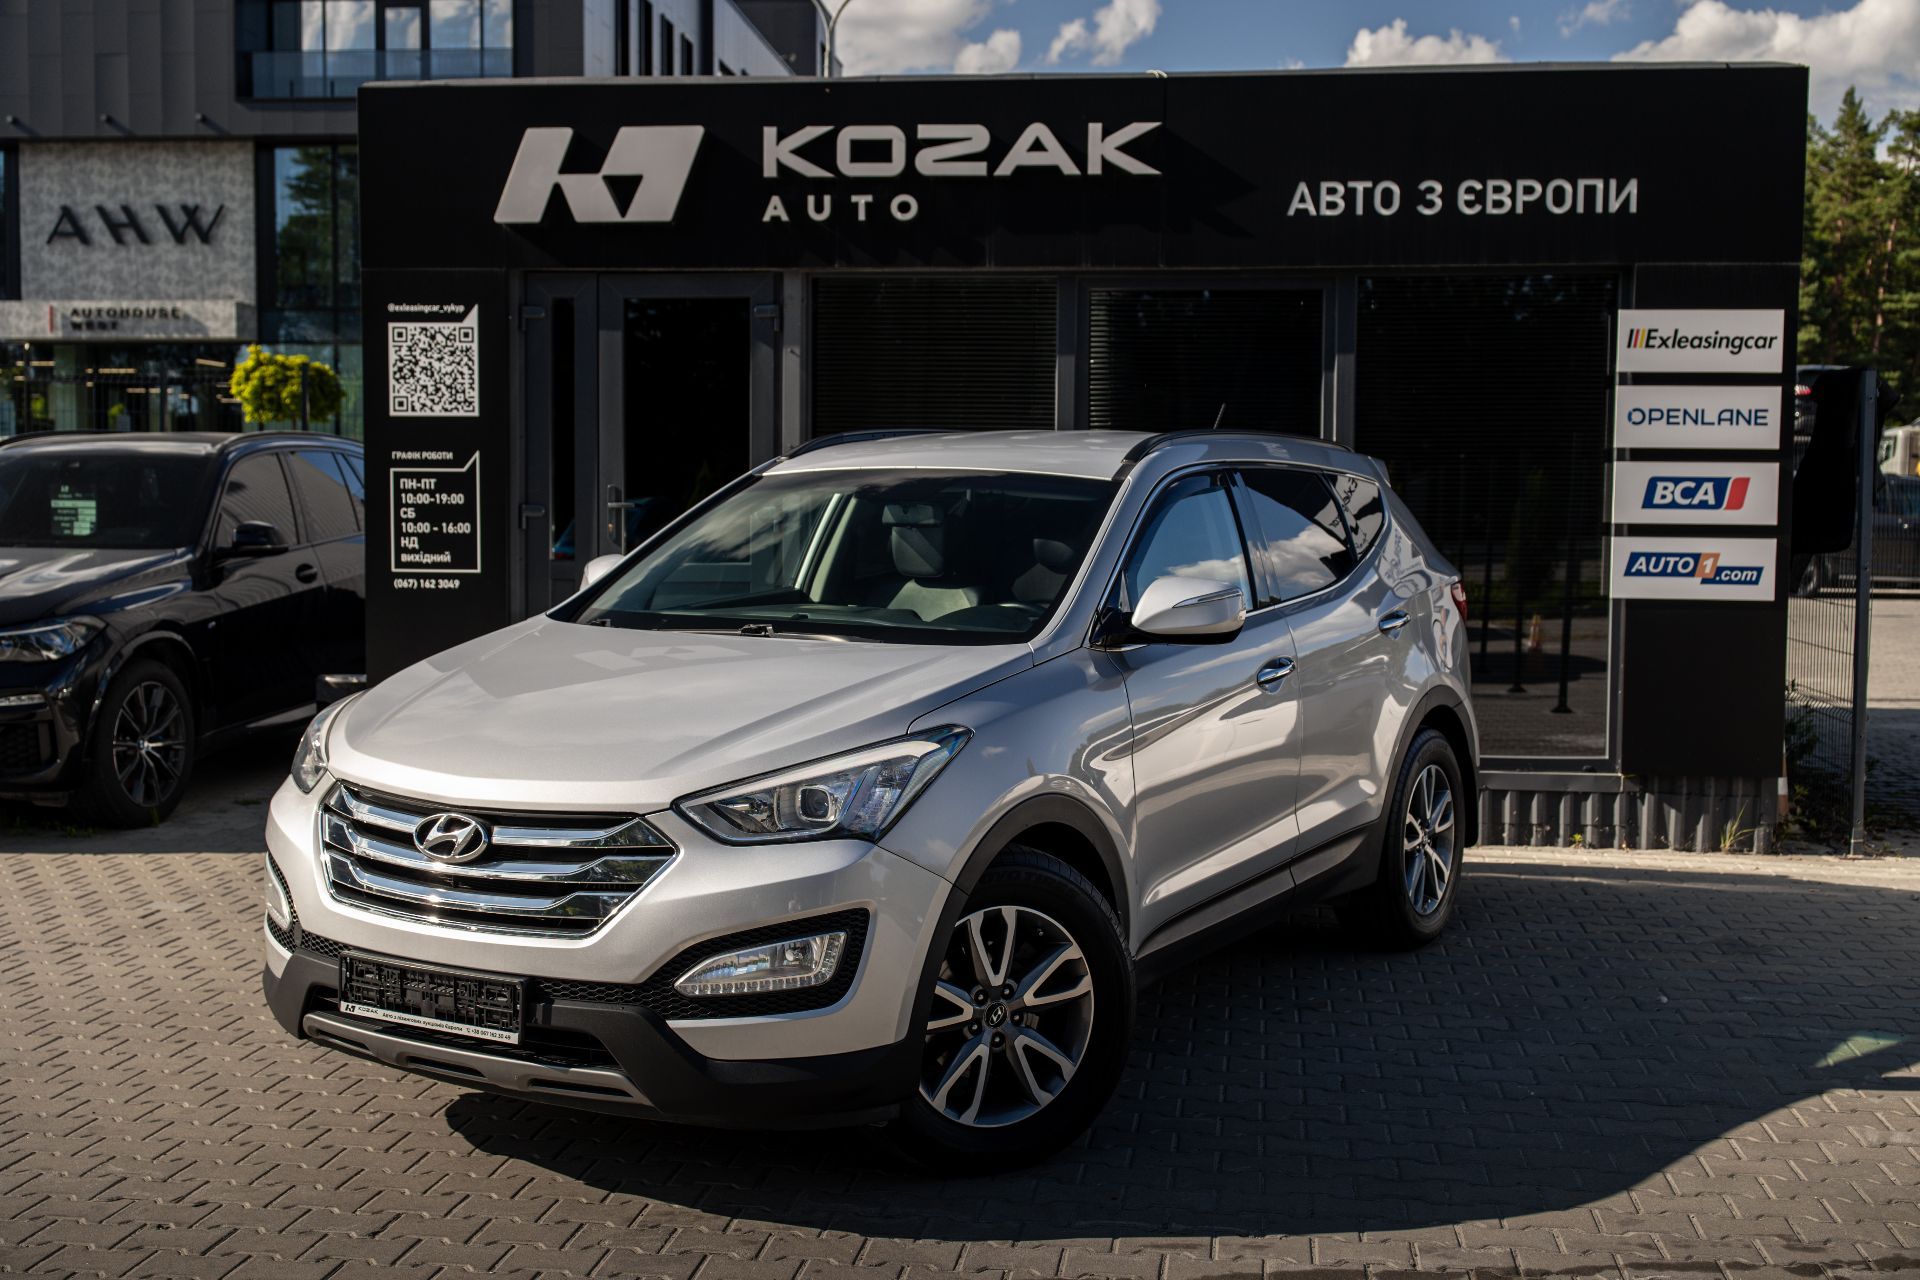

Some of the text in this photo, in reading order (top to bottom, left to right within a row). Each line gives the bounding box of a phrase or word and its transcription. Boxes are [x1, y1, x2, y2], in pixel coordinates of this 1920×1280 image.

[762, 121, 1163, 178] KOZAK
[1287, 180, 1401, 217] АВТО
[1457, 178, 1638, 216] ЄВРОПИ
[762, 193, 919, 223] AUTO
[46, 204, 225, 246] AHW
[70, 306, 181, 320] AUTOHOUSE
[1644, 328, 1778, 356] Exleasingcar
[1627, 407, 1769, 427] OPENLANE
[391, 450, 454, 461] ГРАФІК РОБОТИ
[399, 477, 437, 491] ПН-ПТ
[400, 492, 465, 505] 10:00-19:00
[1651, 481, 1718, 507] BCA
[399, 507, 417, 519] СБ
[401, 521, 431, 534] 10:00
[441, 521, 472, 534] 16:00
[400, 536, 420, 550] НД
[400, 550, 452, 565] вихідний
[393, 577, 461, 590] (067) 162 3049
